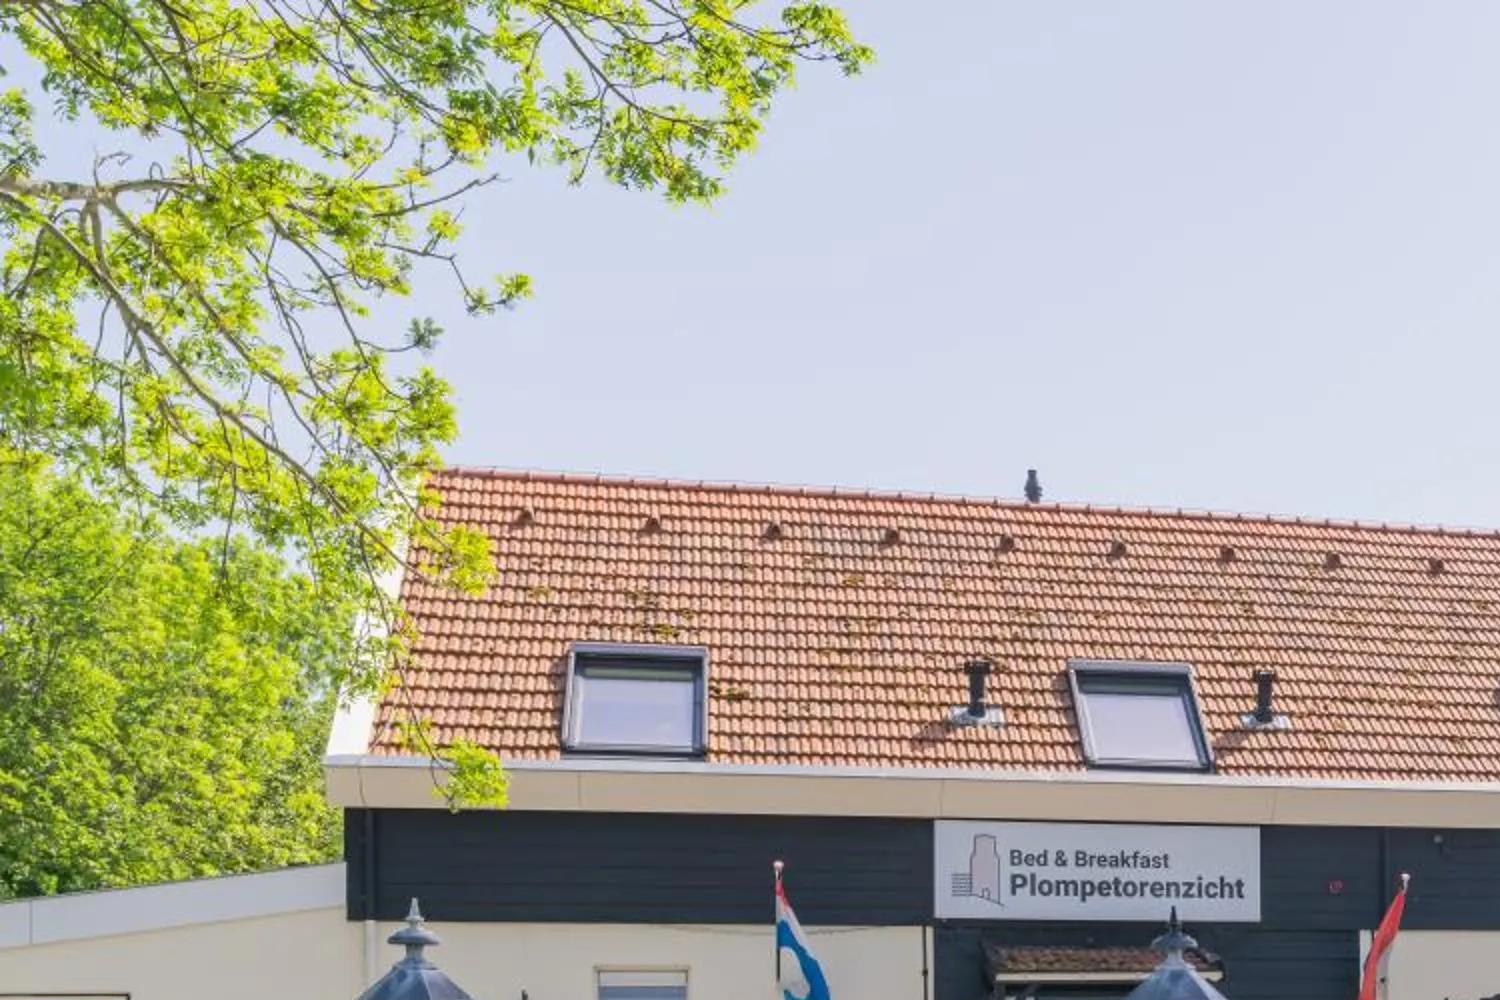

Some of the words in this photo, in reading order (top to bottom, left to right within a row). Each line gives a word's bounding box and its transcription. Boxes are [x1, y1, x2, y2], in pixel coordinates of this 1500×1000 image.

[1009, 849, 1049, 867] Bed
[1054, 850, 1069, 867] &
[1075, 851, 1170, 869] Breakfast
[1010, 873, 1246, 902] Plompetorenzicht
